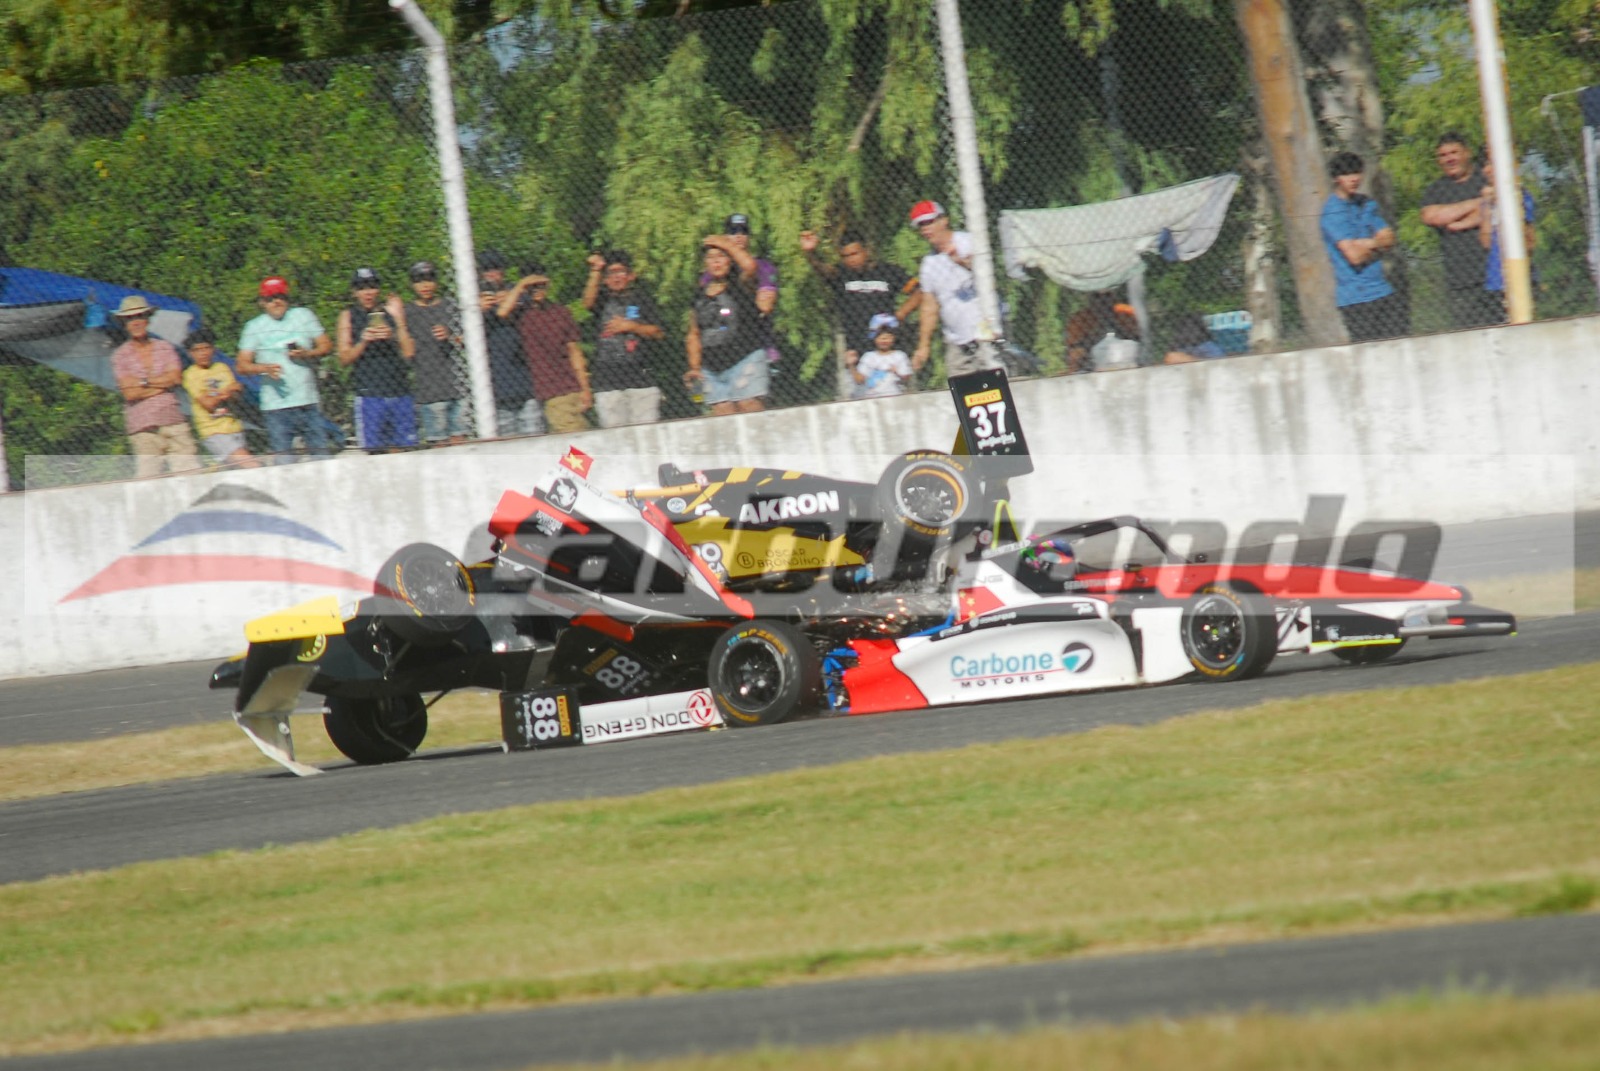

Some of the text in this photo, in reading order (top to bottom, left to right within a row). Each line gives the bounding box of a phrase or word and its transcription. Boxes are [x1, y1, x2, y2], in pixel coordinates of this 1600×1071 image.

[969, 401, 1006, 438] 37
[739, 491, 839, 524] AKRON
[765, 548, 806, 557] OSCAR
[595, 655, 641, 689] 88
[951, 652, 1053, 678] Carbone
[961, 674, 1044, 688] MOTORS
[531, 697, 559, 741] 88
